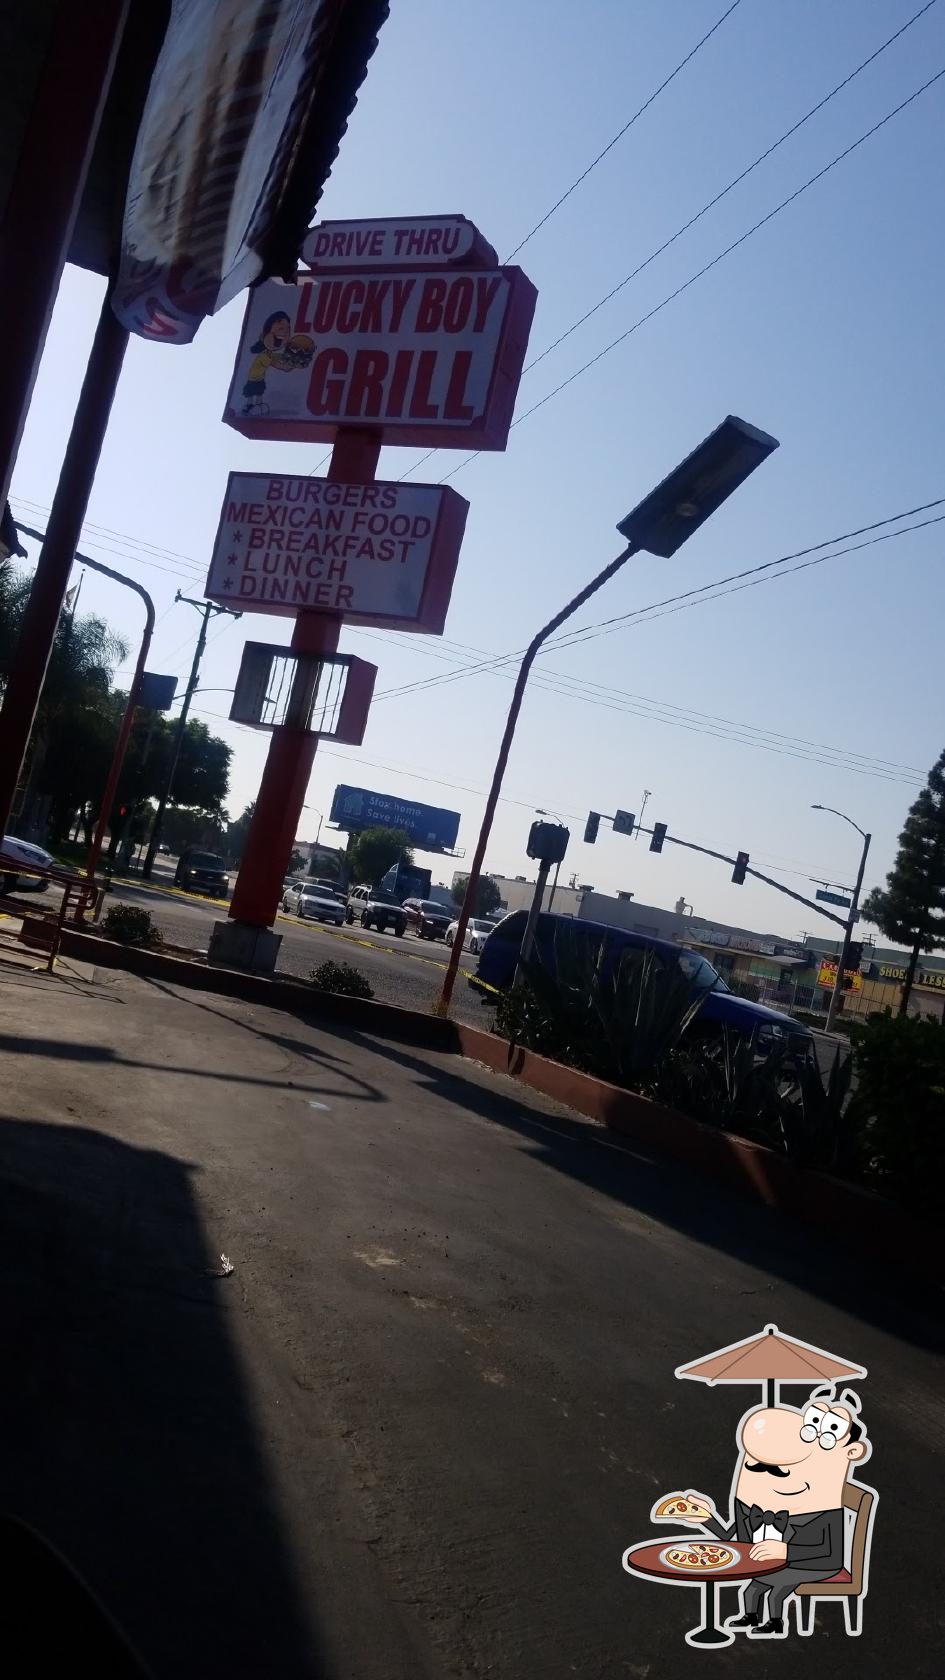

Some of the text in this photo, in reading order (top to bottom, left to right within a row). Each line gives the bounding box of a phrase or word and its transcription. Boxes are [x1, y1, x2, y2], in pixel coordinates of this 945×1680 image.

[314, 228, 461, 258] DRIVE THRU
[294, 277, 501, 334] LUCKY BOY
[306, 347, 474, 420] GRILL
[265, 480, 399, 509] BURGERS
[226, 502, 431, 539] MEXICAN FOOD
[248, 528, 416, 563] BREAKFAST
[243, 553, 347, 582] LUNCH
[239, 576, 354, 608] DINNER
[367, 808, 390, 822] Save
[879, 966, 907, 980] SHOE
